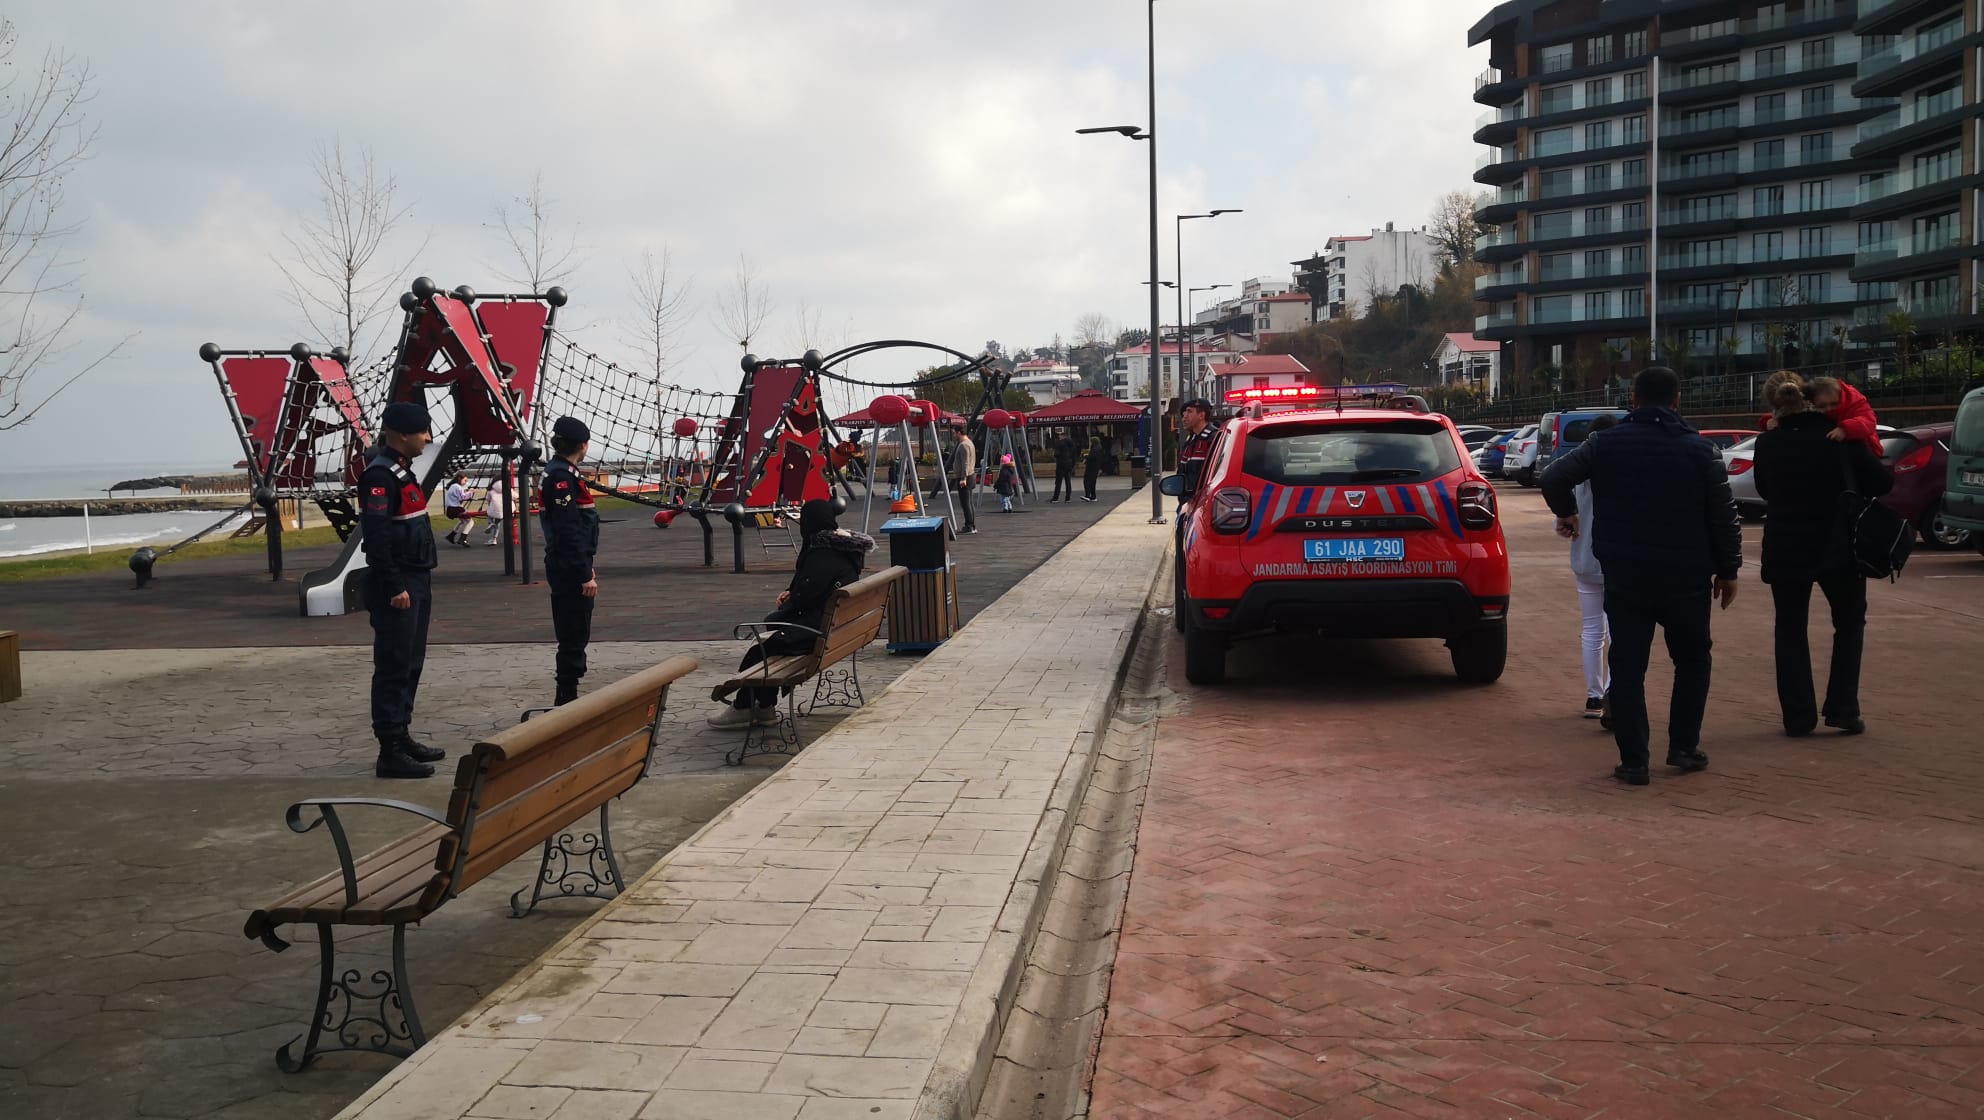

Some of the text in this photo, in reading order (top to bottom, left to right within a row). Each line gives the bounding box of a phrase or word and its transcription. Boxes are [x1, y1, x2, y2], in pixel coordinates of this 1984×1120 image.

[1315, 540, 1400, 556] 61 JAA 290
[1253, 563, 1309, 576] JANDARMA
